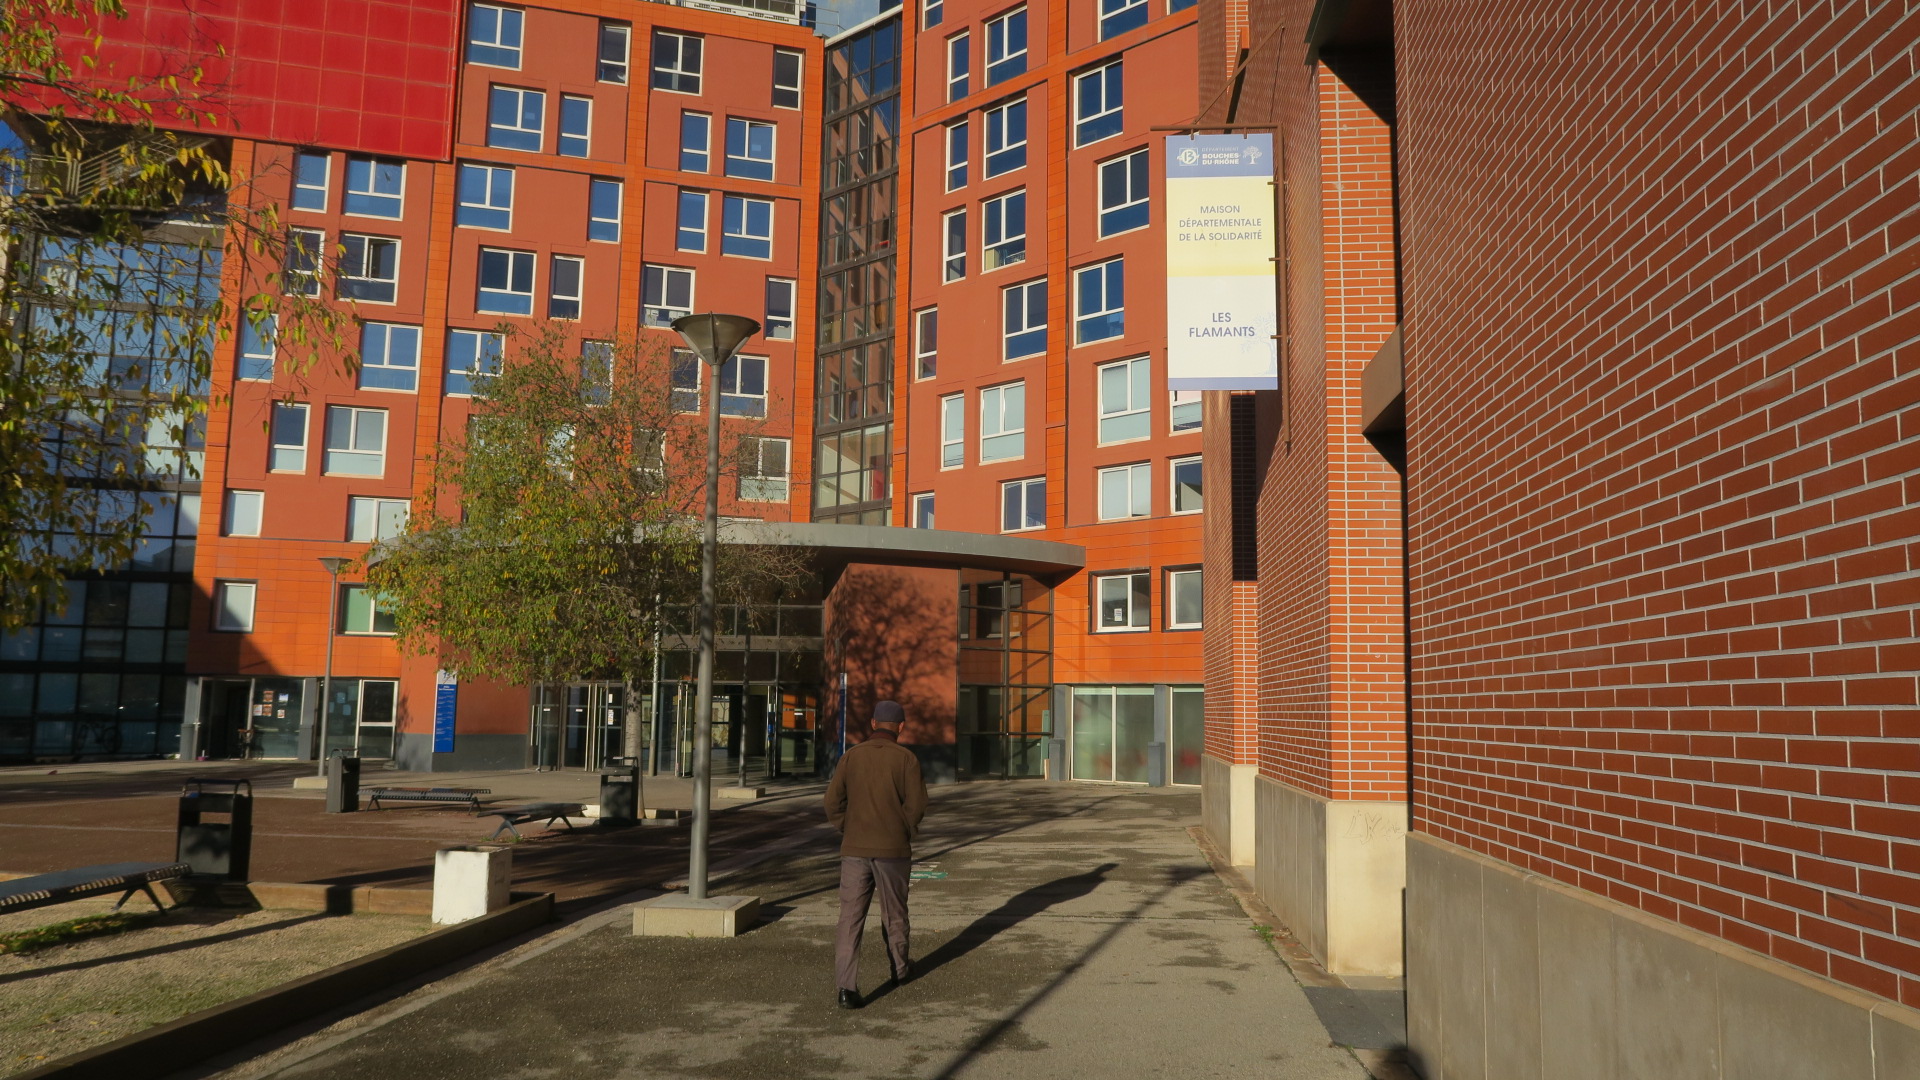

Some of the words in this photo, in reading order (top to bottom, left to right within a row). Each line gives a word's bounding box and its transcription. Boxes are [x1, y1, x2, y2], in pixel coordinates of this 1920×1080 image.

[1200, 205, 1240, 214] MAISON
[1179, 217, 1262, 228] DÉPARTEMENTALE
[1179, 233, 1191, 241] DE
[1194, 232, 1206, 241] LA
[1208, 230, 1262, 240] SOLIDARITÉ
[1212, 312, 1232, 323] LES
[1189, 326, 1255, 338] FLAMANTS
